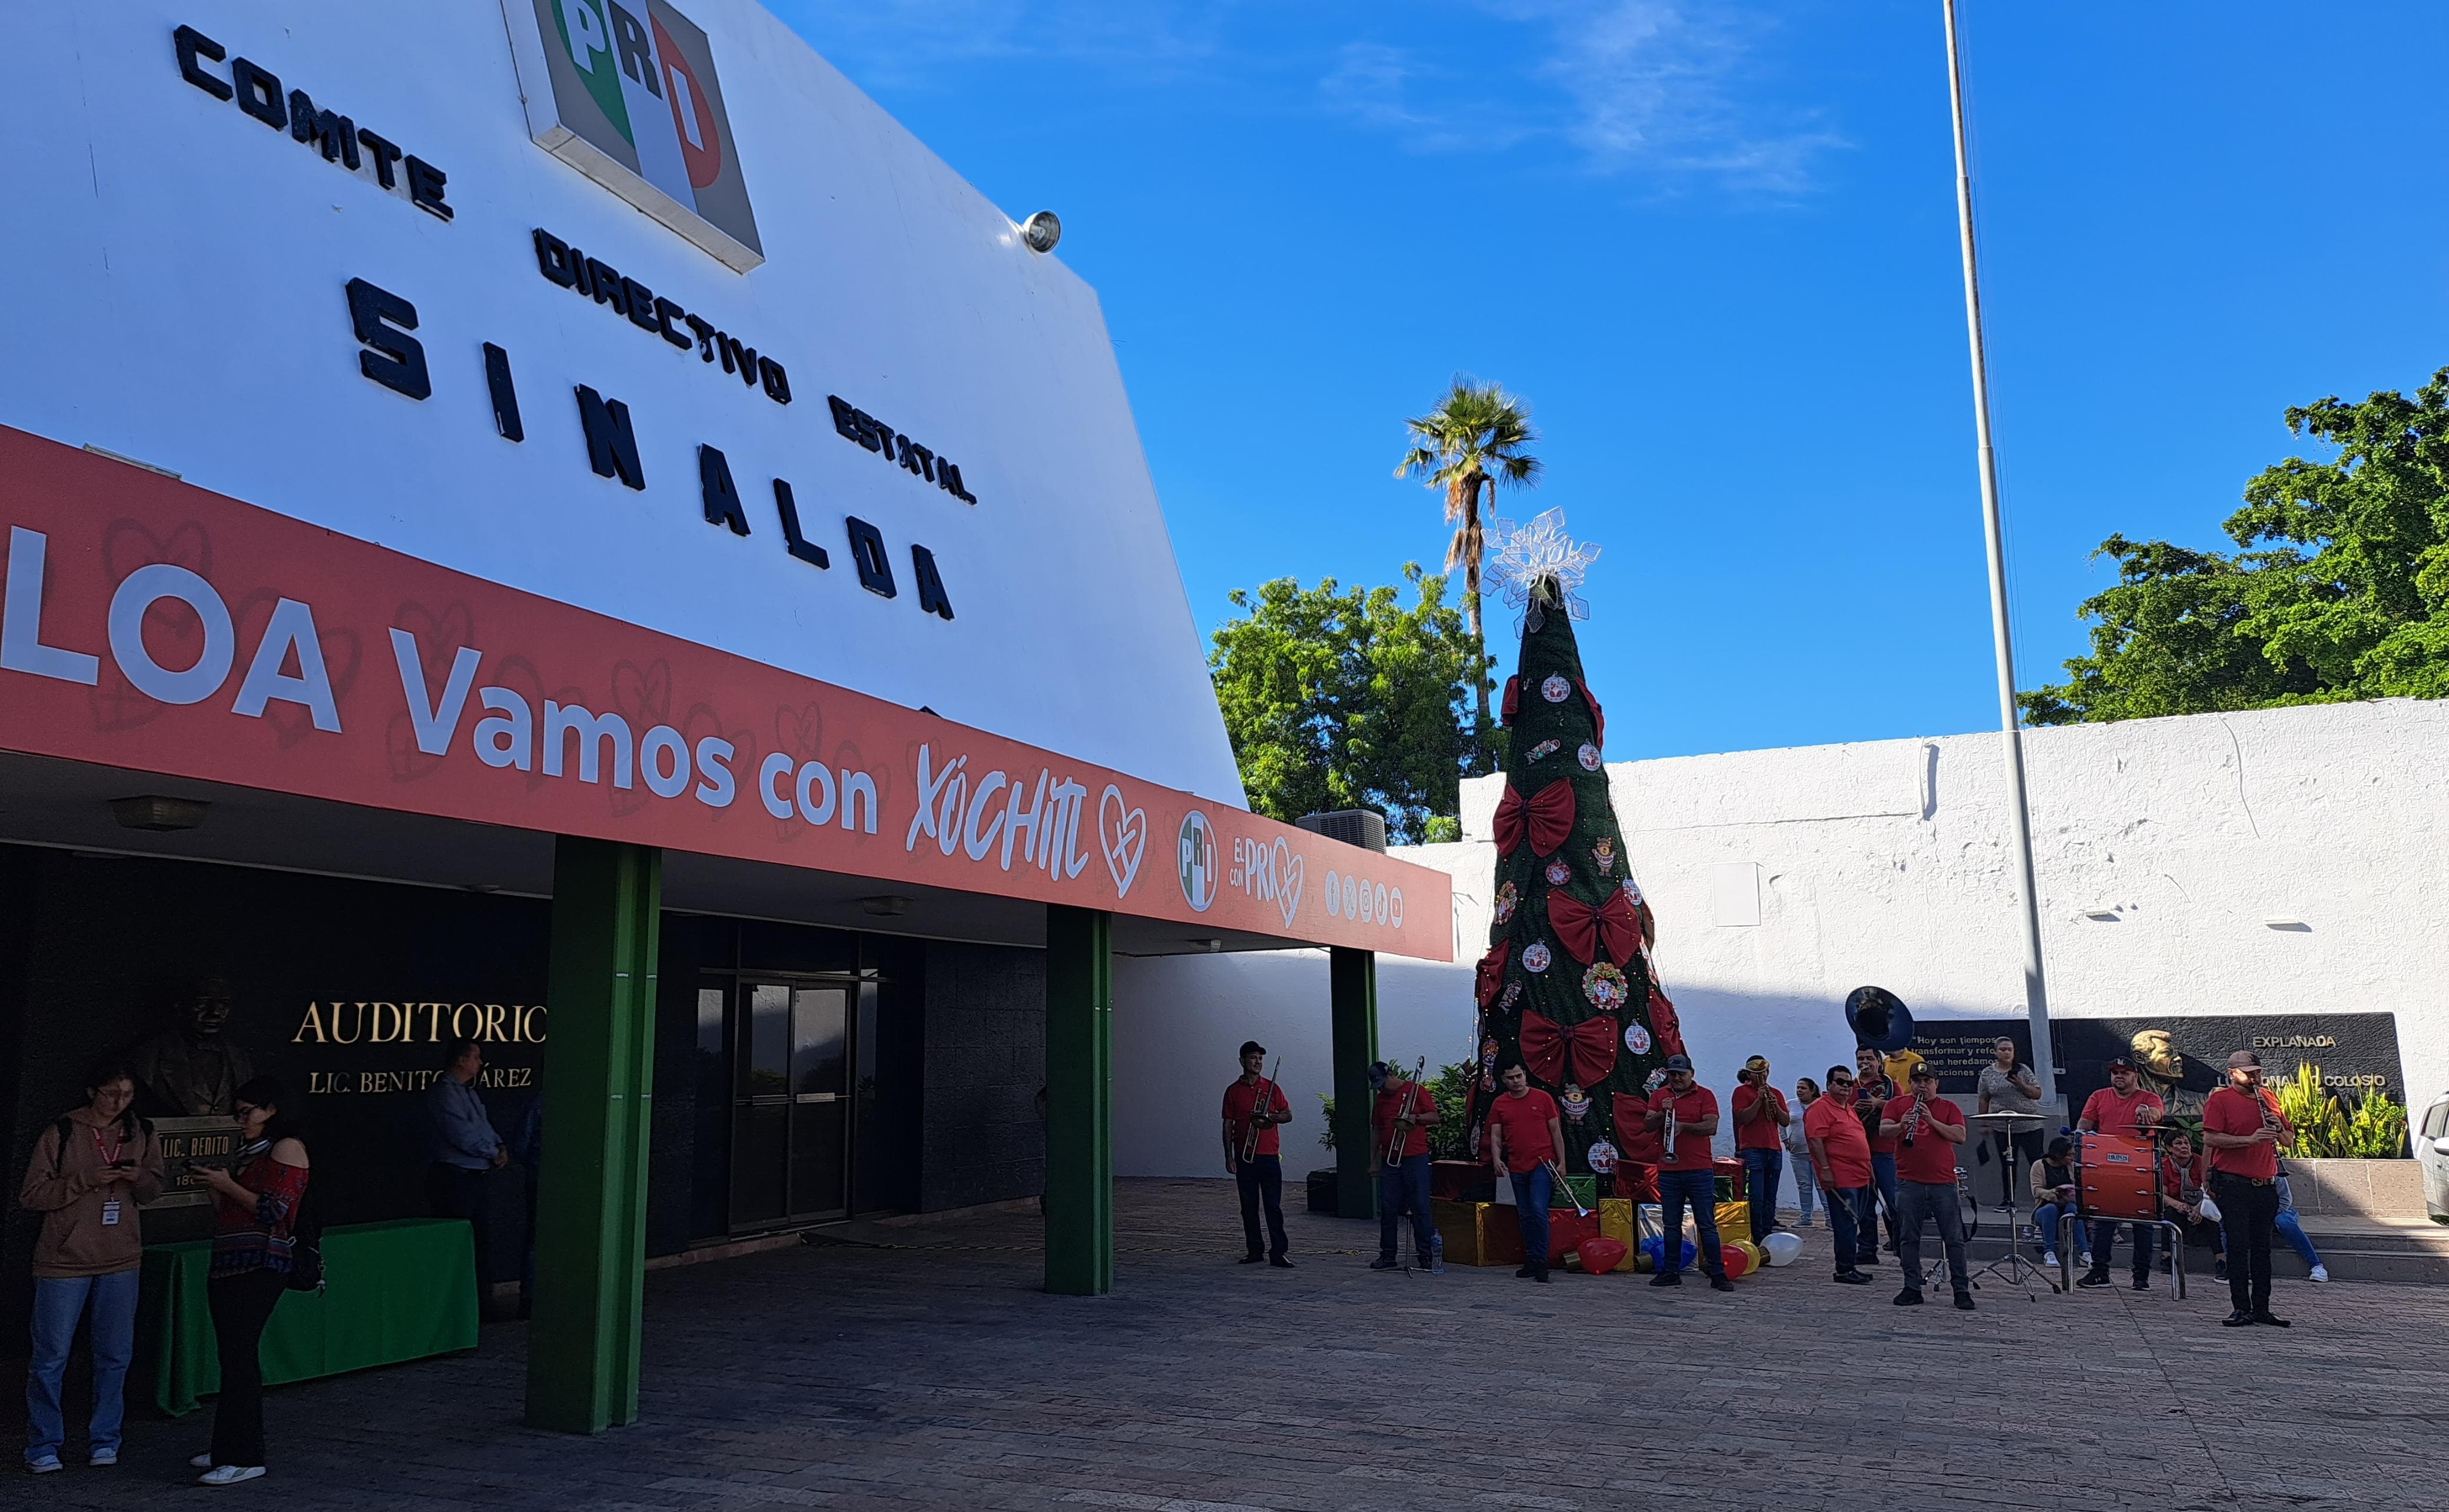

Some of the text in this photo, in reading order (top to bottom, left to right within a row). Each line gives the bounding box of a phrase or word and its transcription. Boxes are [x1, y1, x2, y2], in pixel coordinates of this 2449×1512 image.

[560, 0, 704, 152] PRI
[174, 24, 978, 505] COMITE DIRECTIVO ESTATAL
[345, 277, 955, 622] SINALOA
[389, 627, 736, 807] Vamos
[759, 752, 877, 835] con
[1182, 827, 1212, 882] PRI
[1235, 838, 1245, 863] EL
[1229, 868, 1243, 887] CON
[1245, 838, 1275, 902] PRI
[1911, 1046, 1965, 1055] transformar
[1959, 1036, 1996, 1045] tiempos
[2252, 1035, 2337, 1048] EXPLANADA
[308, 1071, 351, 1094] LIC.
[162, 1135, 229, 1158] LIC. BENITO
